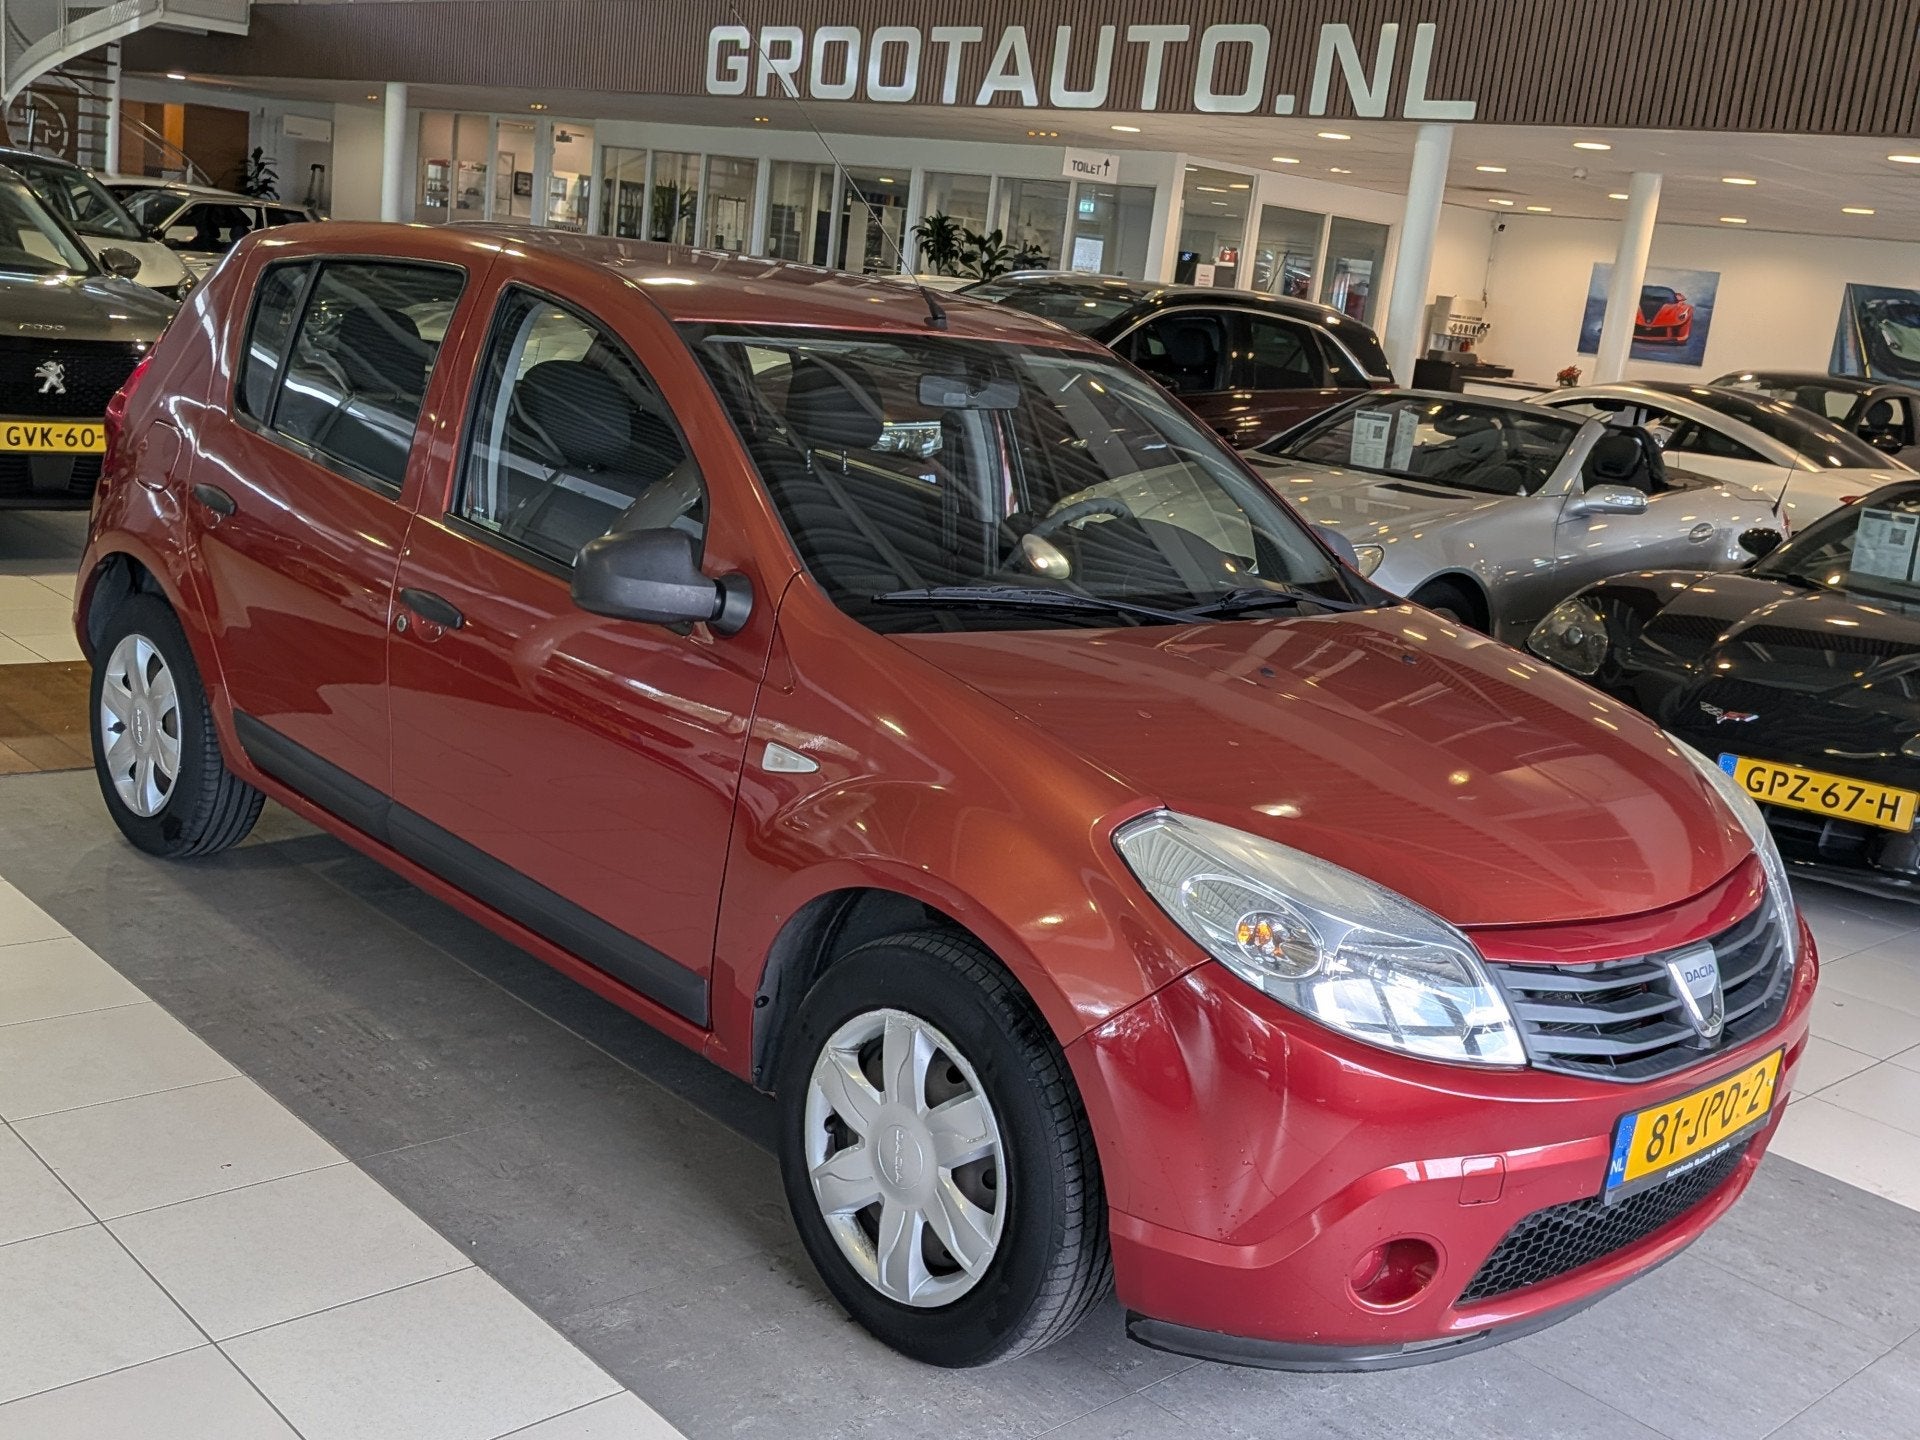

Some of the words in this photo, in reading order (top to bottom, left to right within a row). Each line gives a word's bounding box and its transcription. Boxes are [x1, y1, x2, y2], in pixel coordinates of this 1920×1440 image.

[706, 22, 1477, 120] GROOTAUTO.NL
[1072, 159, 1102, 175] TOILET
[6, 426, 104, 448] GVK-60-
[1745, 766, 1901, 822] GPZ-67-H
[1684, 963, 1716, 984] DACIA
[1610, 1157, 1625, 1176] NL
